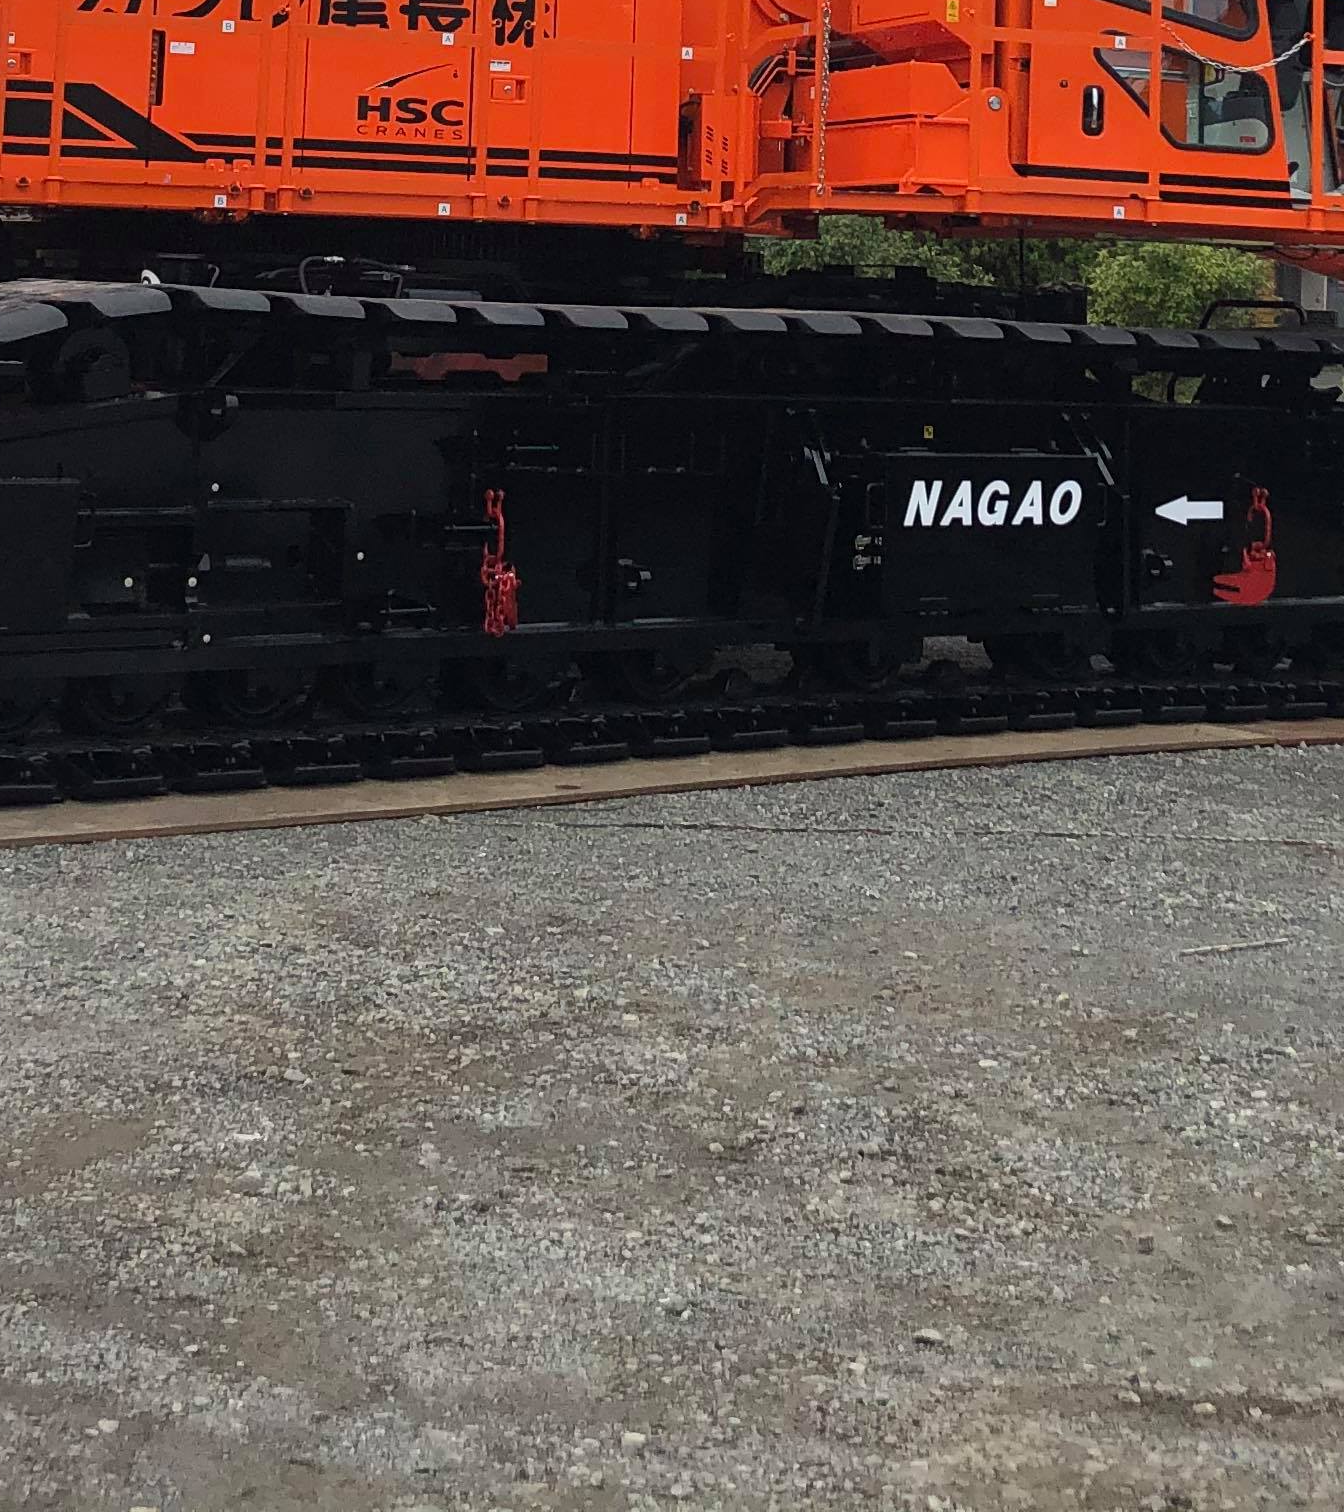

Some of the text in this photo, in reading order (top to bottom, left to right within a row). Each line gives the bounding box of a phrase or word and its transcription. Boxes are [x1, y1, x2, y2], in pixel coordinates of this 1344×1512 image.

[357, 95, 464, 126] HSC
[356, 124, 463, 140] CRANES
[903, 480, 1083, 527] NAGAO
